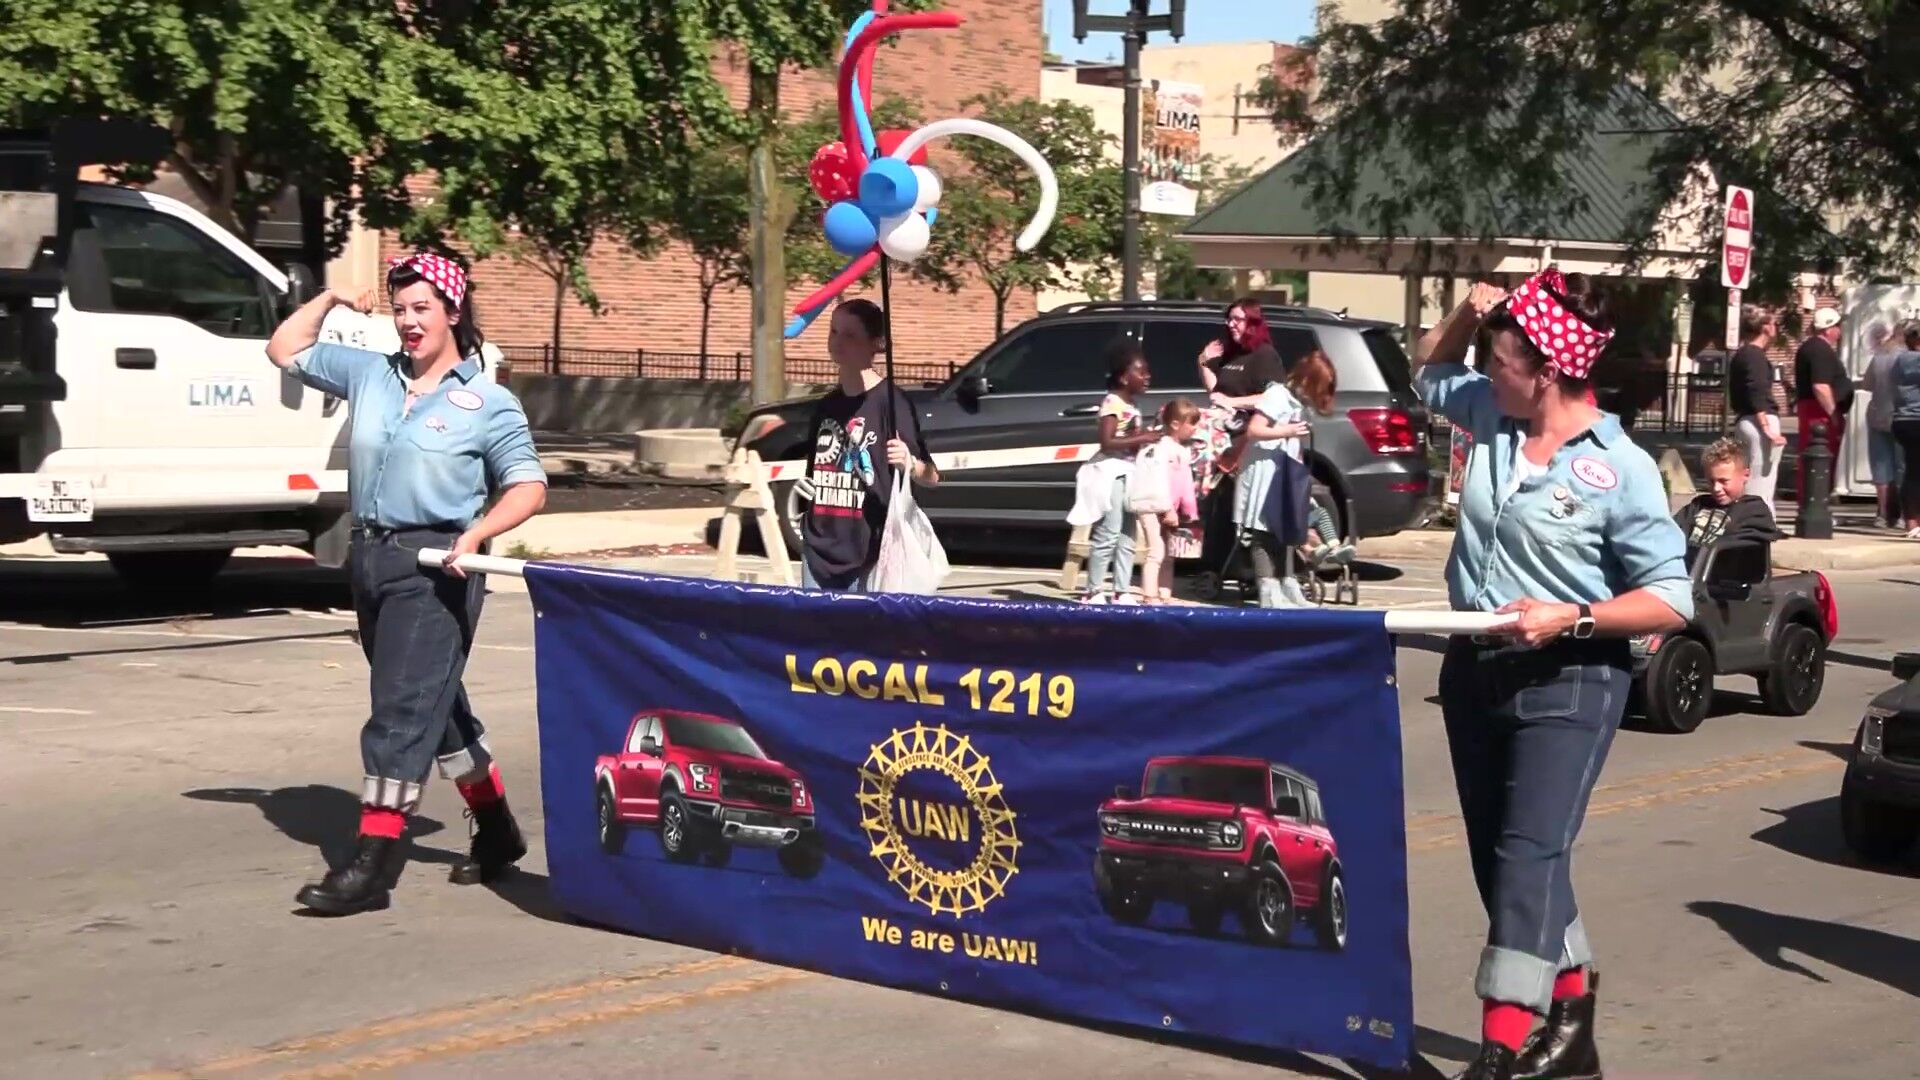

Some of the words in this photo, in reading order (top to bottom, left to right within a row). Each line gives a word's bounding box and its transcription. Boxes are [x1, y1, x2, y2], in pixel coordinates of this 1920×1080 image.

[1156, 109, 1201, 130] LIMA
[189, 383, 254, 406] LIMA
[785, 654, 945, 706] LOCAL
[959, 667, 1075, 719] 1219
[899, 797, 969, 842] UAW
[861, 916, 902, 945] We
[910, 929, 955, 953] are
[962, 932, 1038, 966] UAW!
